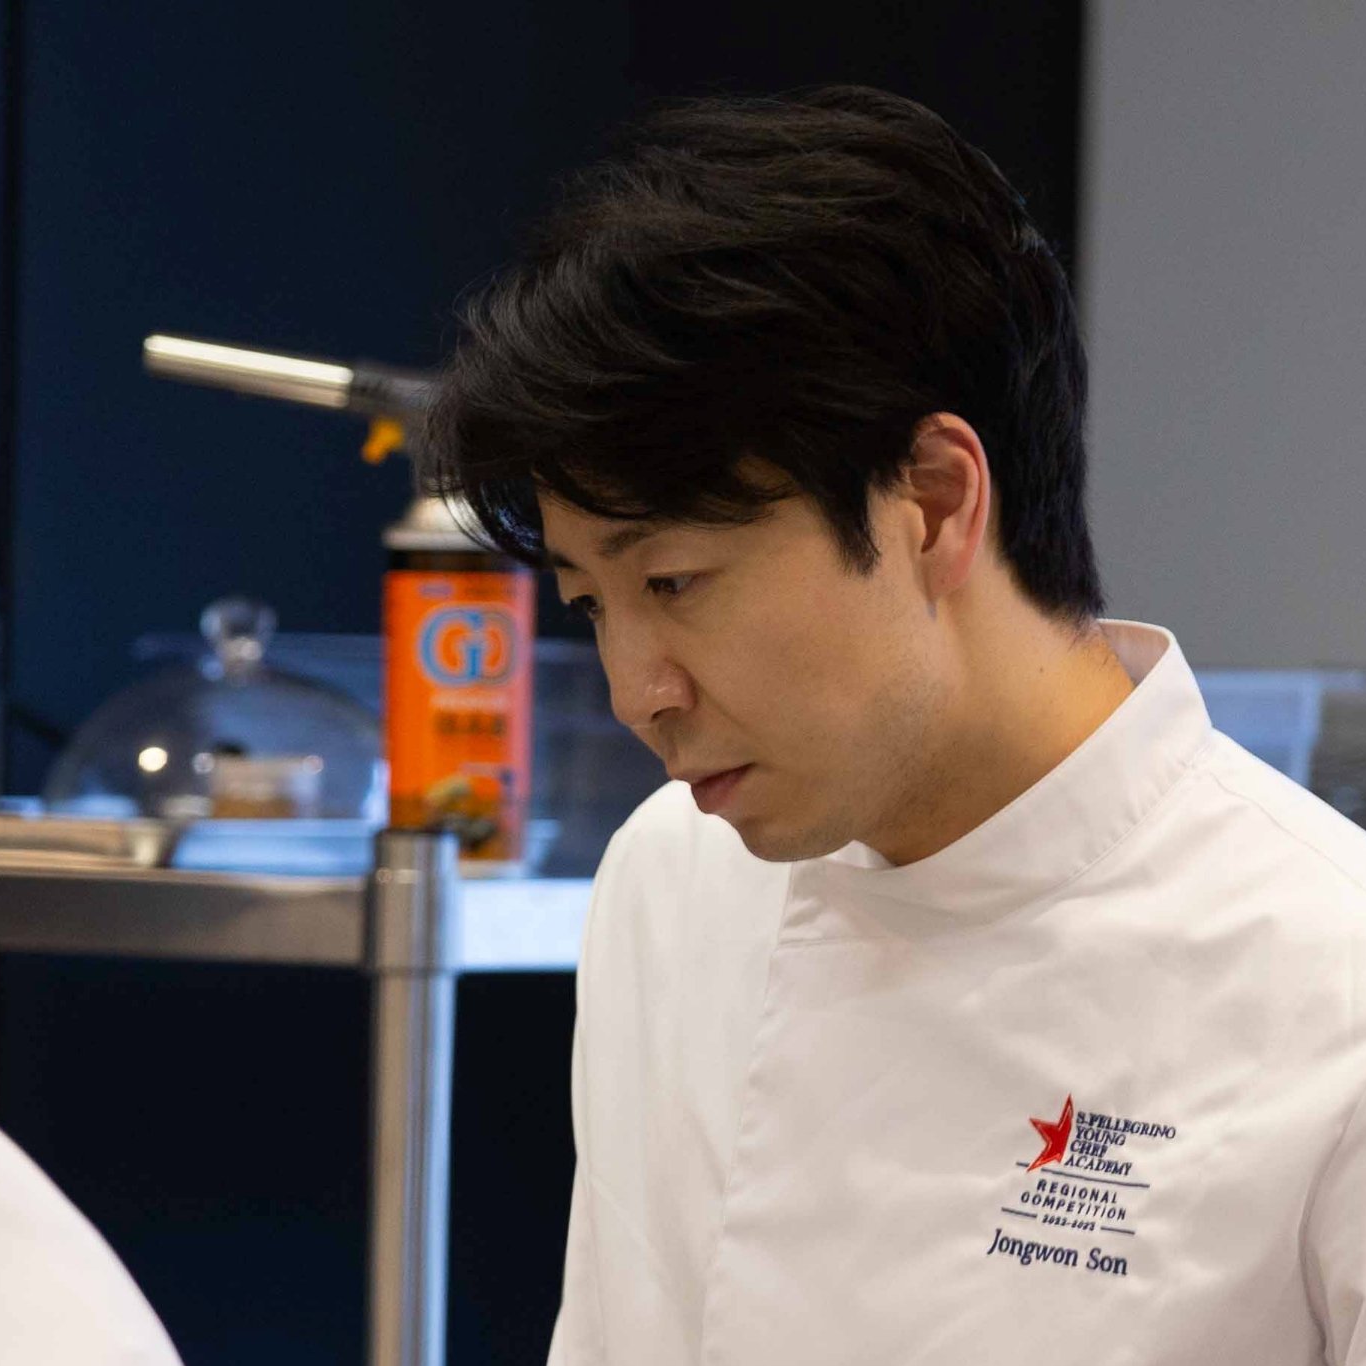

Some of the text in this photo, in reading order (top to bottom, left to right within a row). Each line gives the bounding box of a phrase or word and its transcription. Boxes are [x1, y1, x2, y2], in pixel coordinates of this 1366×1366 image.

[1076, 1111, 1177, 1139] S.PELLEGRINO
[1076, 1125, 1126, 1146] YOUNG
[1070, 1140, 1108, 1158] CHEF
[1064, 1154, 1132, 1176] ACADEMY
[1036, 1179, 1117, 1204] REGIONAL
[1020, 1191, 1126, 1220] COMPETITION
[987, 1228, 1128, 1276] Jongwon Son
